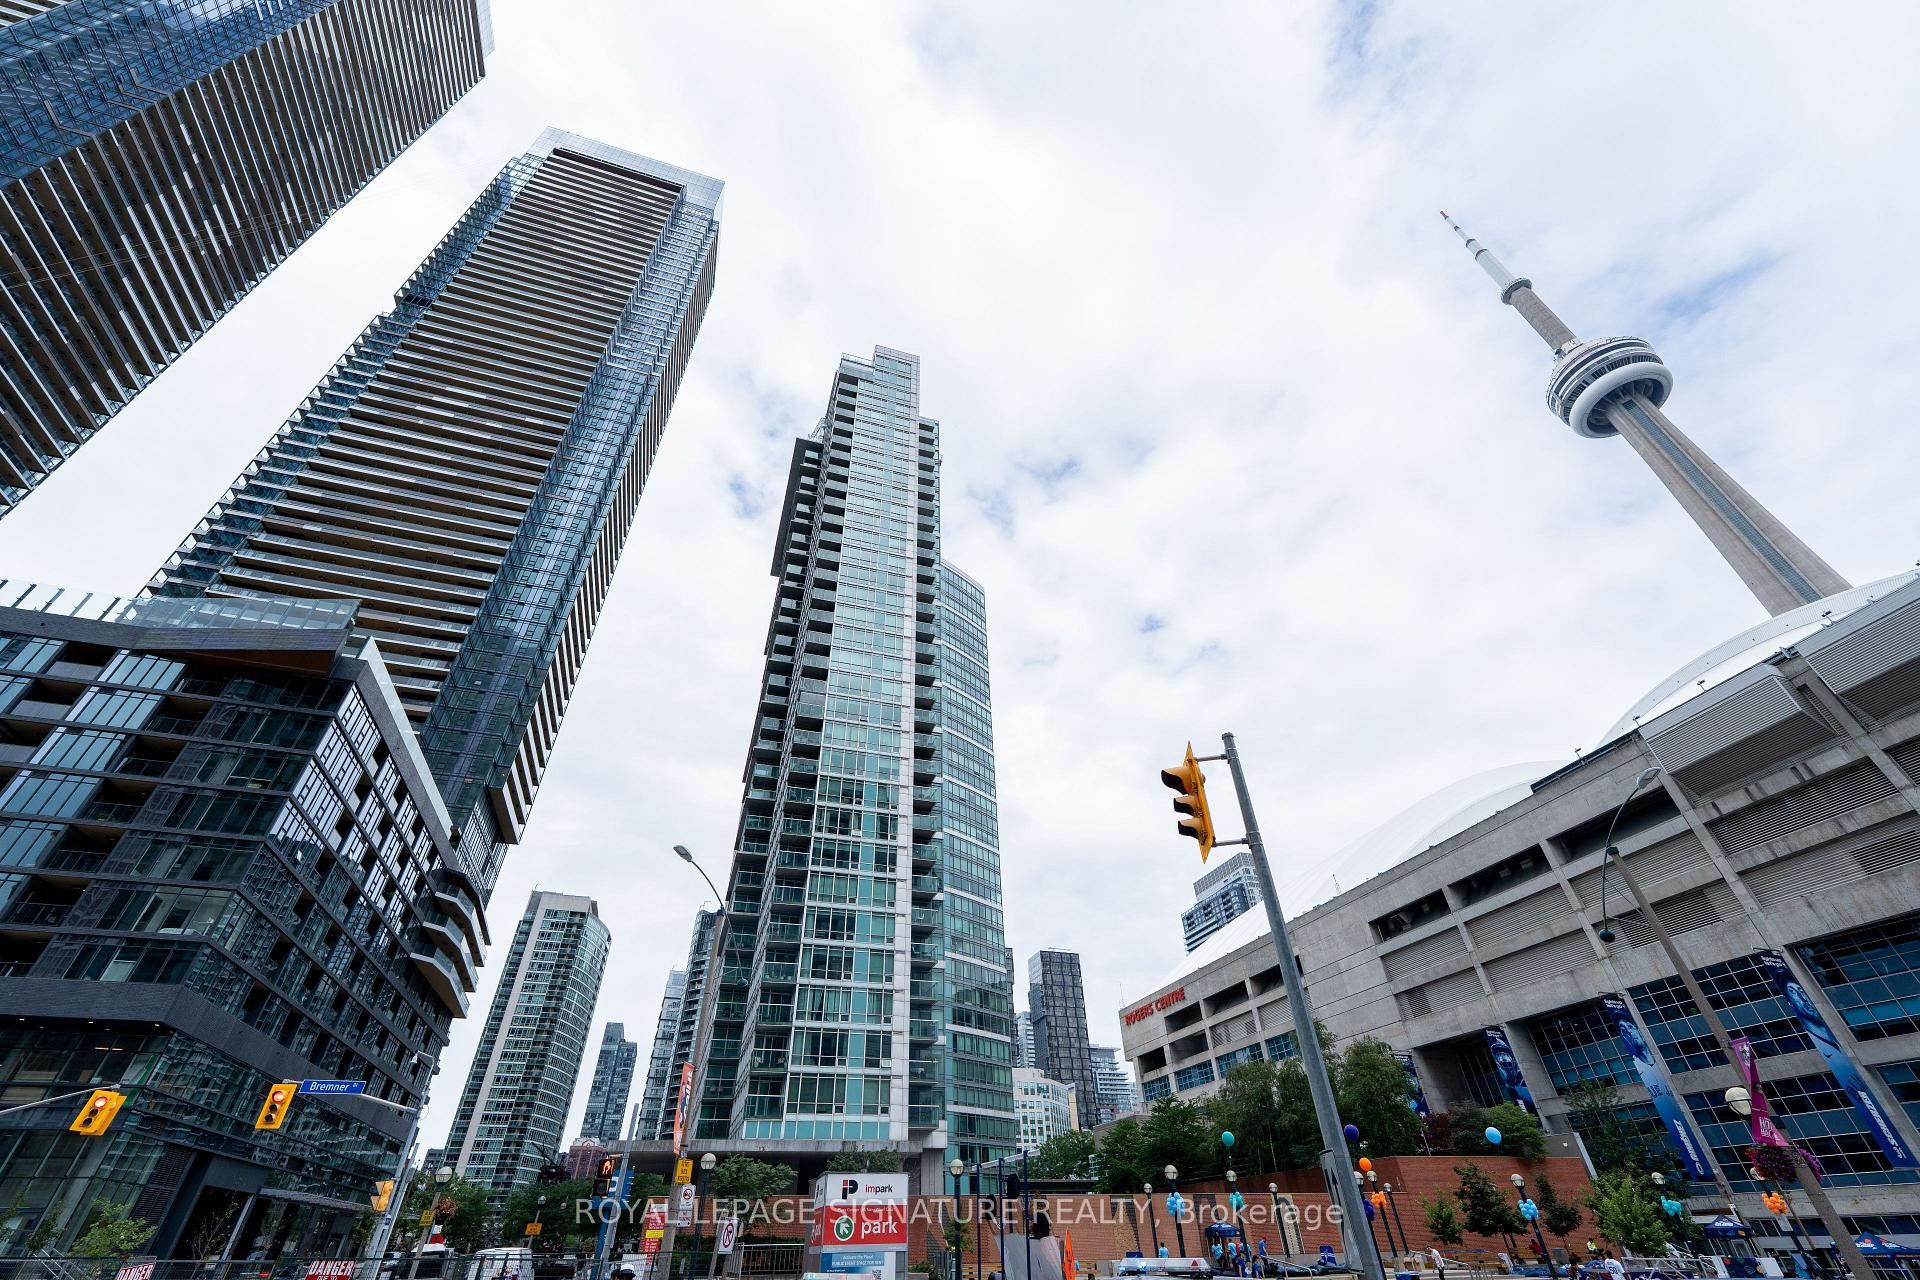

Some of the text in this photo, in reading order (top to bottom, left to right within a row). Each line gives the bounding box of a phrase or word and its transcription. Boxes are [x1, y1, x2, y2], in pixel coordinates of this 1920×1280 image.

[1124, 986, 1186, 1026] ROGERS CENTRE
[309, 1081, 350, 1092] Bremner
[865, 1184, 893, 1195] impark
[861, 1216, 898, 1240] park
[116, 1264, 155, 1280] DANGER
[308, 1260, 355, 1276] DANGER
